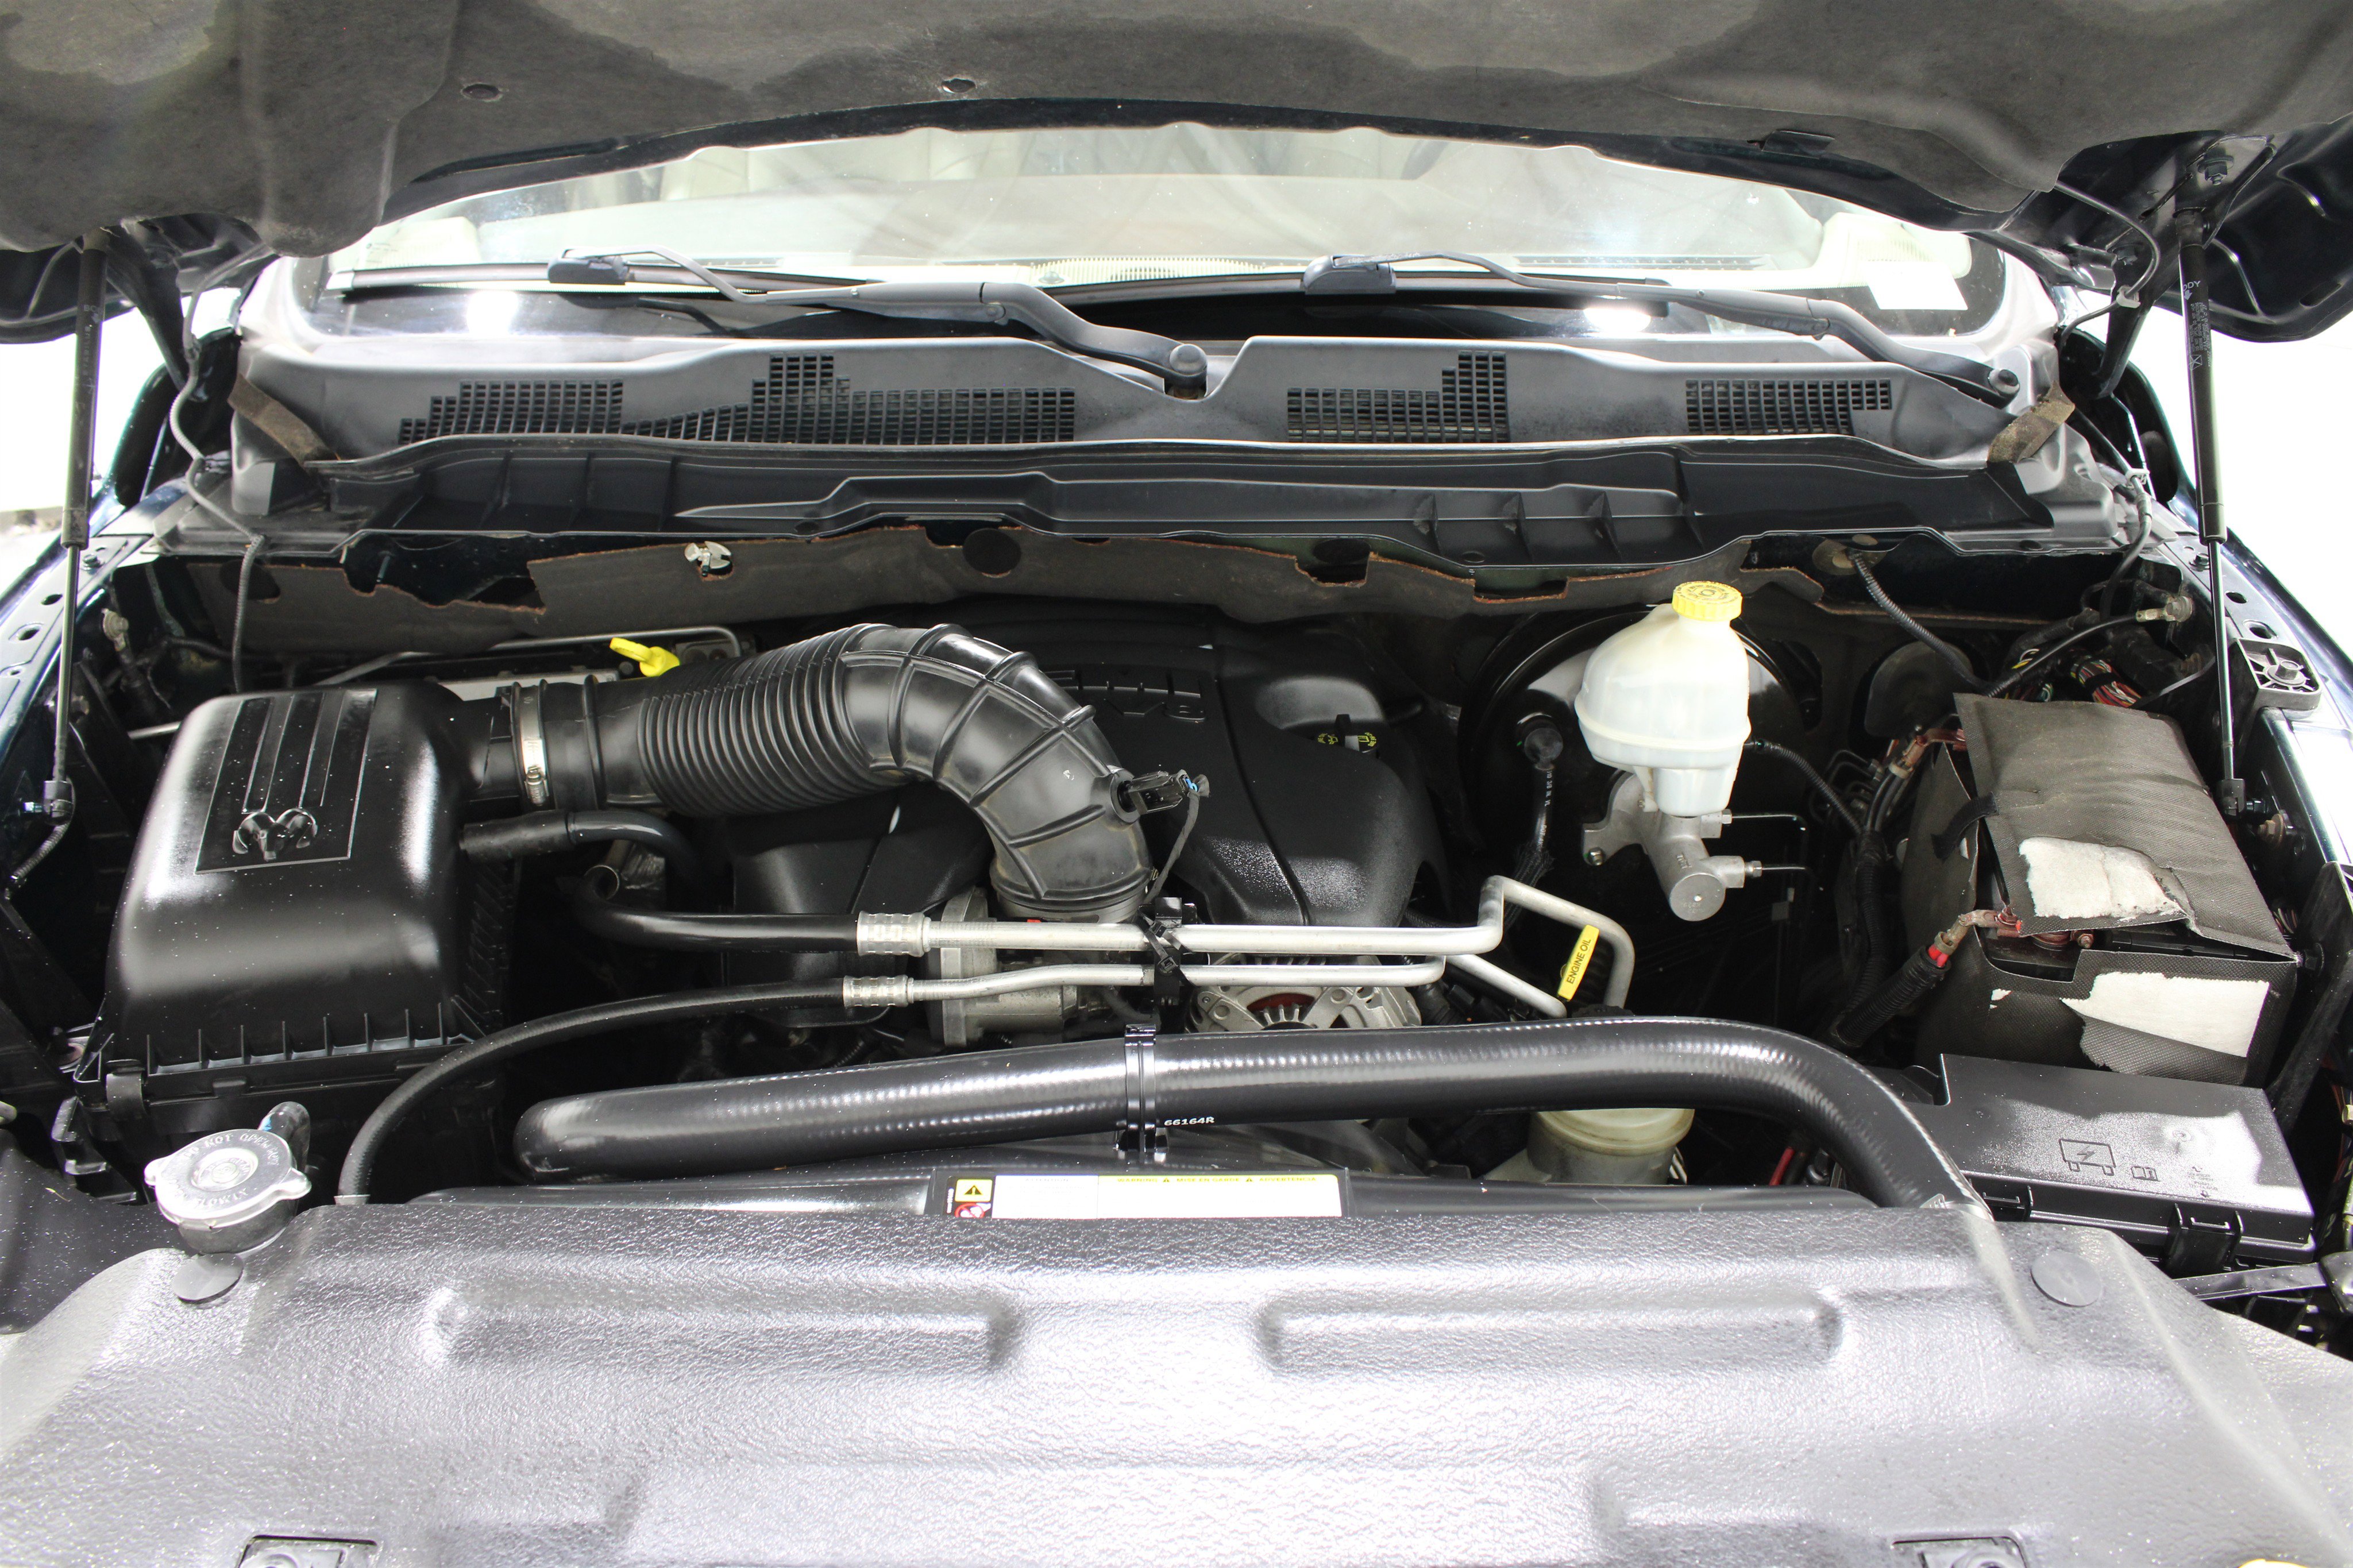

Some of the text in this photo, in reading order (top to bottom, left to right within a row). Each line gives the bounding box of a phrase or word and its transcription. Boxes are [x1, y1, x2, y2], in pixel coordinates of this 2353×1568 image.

[2183, 280, 2201, 291] ODY
[1567, 939, 1591, 984] ENGINE OIL
[1164, 1116, 1215, 1126] 66164R
[205, 1134, 233, 1148] NOT
